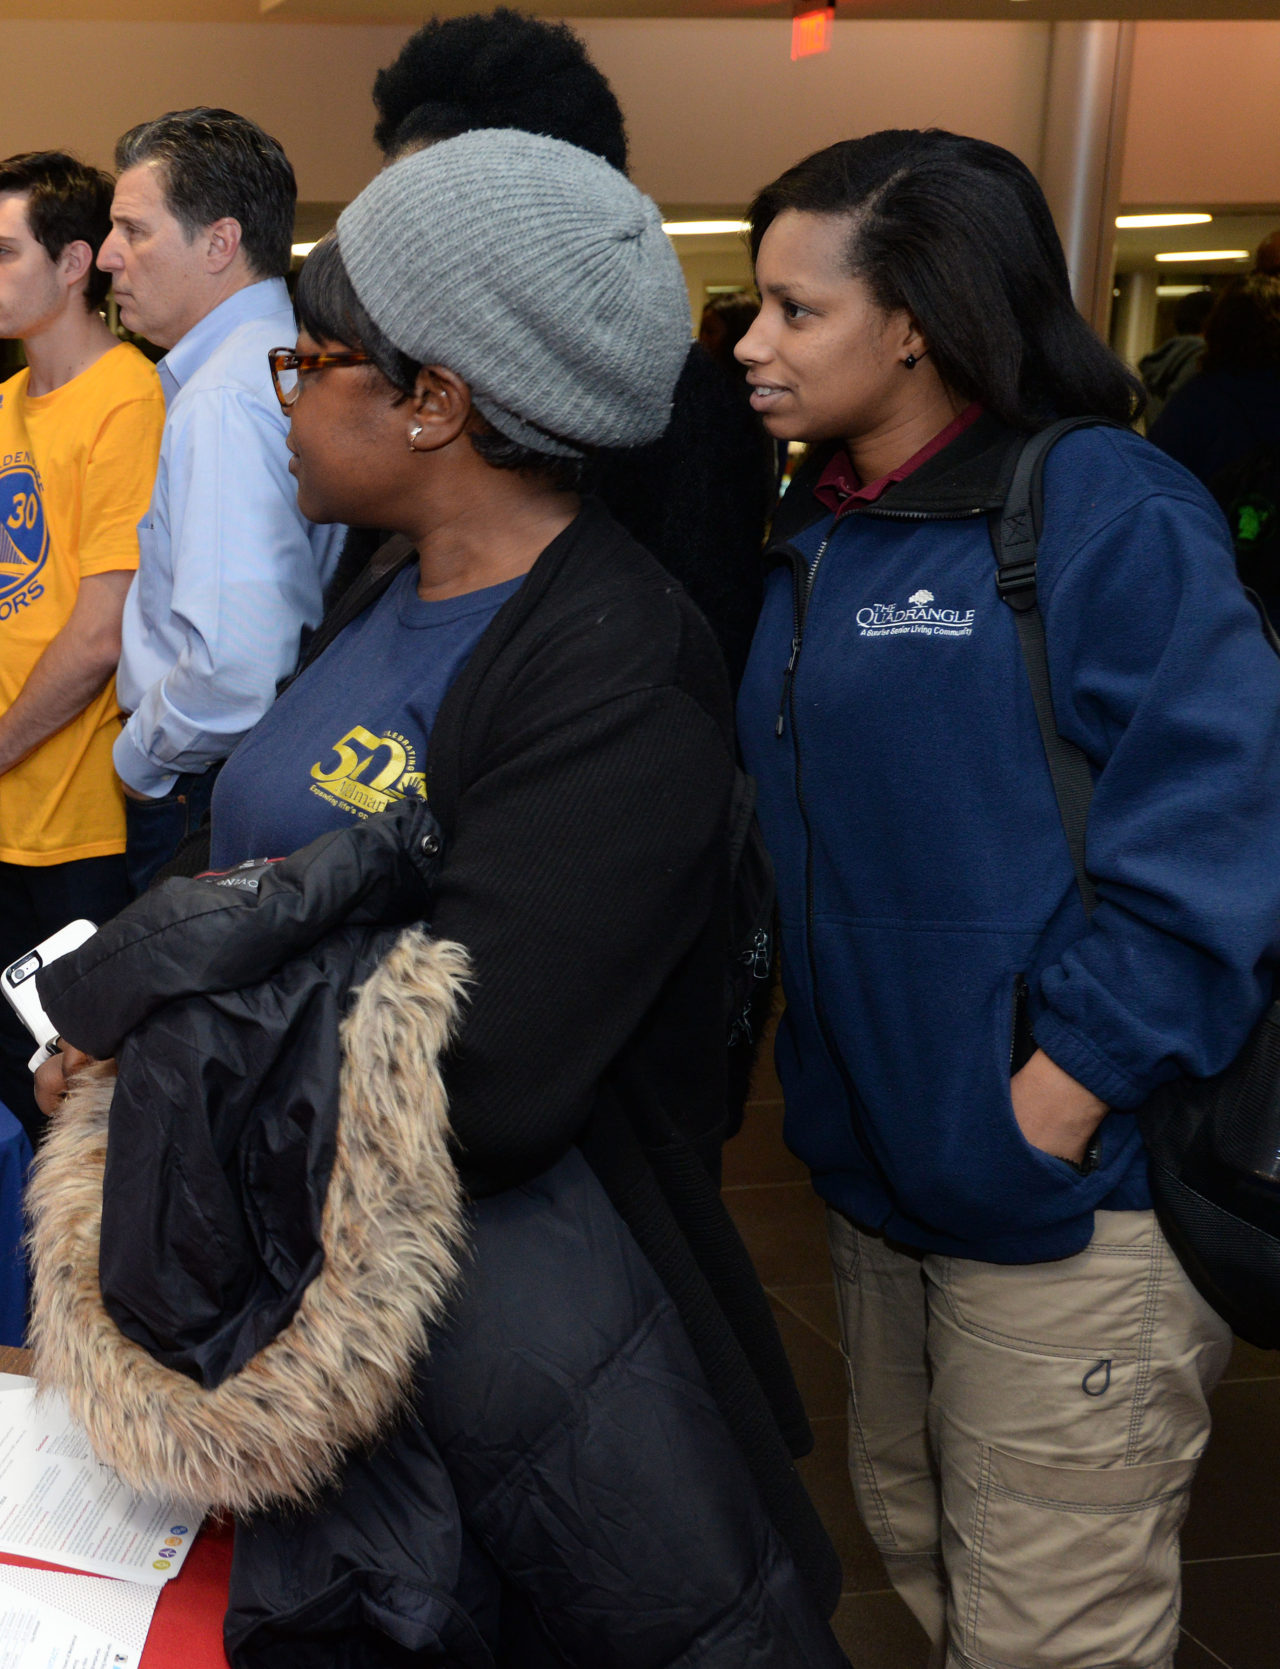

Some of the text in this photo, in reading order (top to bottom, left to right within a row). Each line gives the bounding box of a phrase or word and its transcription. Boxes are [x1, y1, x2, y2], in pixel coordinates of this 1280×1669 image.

[6, 492, 38, 530] 30
[856, 607, 975, 628] QUADRANGLE
[873, 603, 896, 613] THE
[910, 625, 933, 636] Living
[933, 626, 972, 637] Community
[310, 725, 407, 791] 50
[334, 780, 388, 812] Melmar
